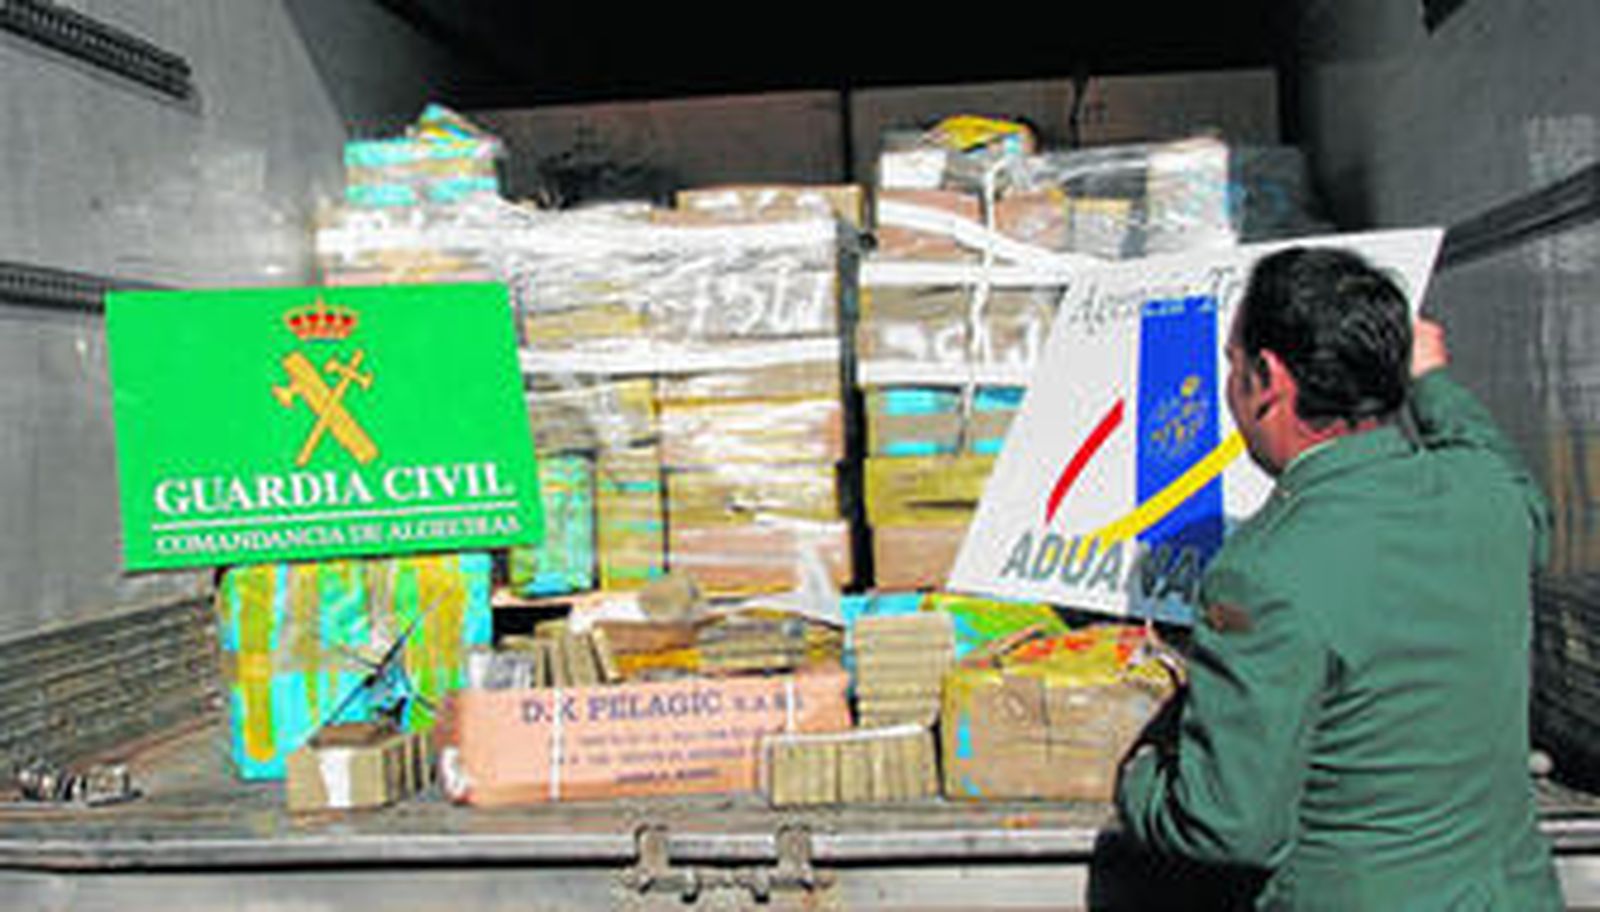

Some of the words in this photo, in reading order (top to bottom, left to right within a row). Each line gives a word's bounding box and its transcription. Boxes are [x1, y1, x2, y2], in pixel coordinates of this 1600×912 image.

[154, 470, 374, 516] GUARDIA
[383, 461, 515, 502] CIVIL
[1000, 529, 1203, 604] ADUANA
[587, 687, 722, 721] PELAGIC
